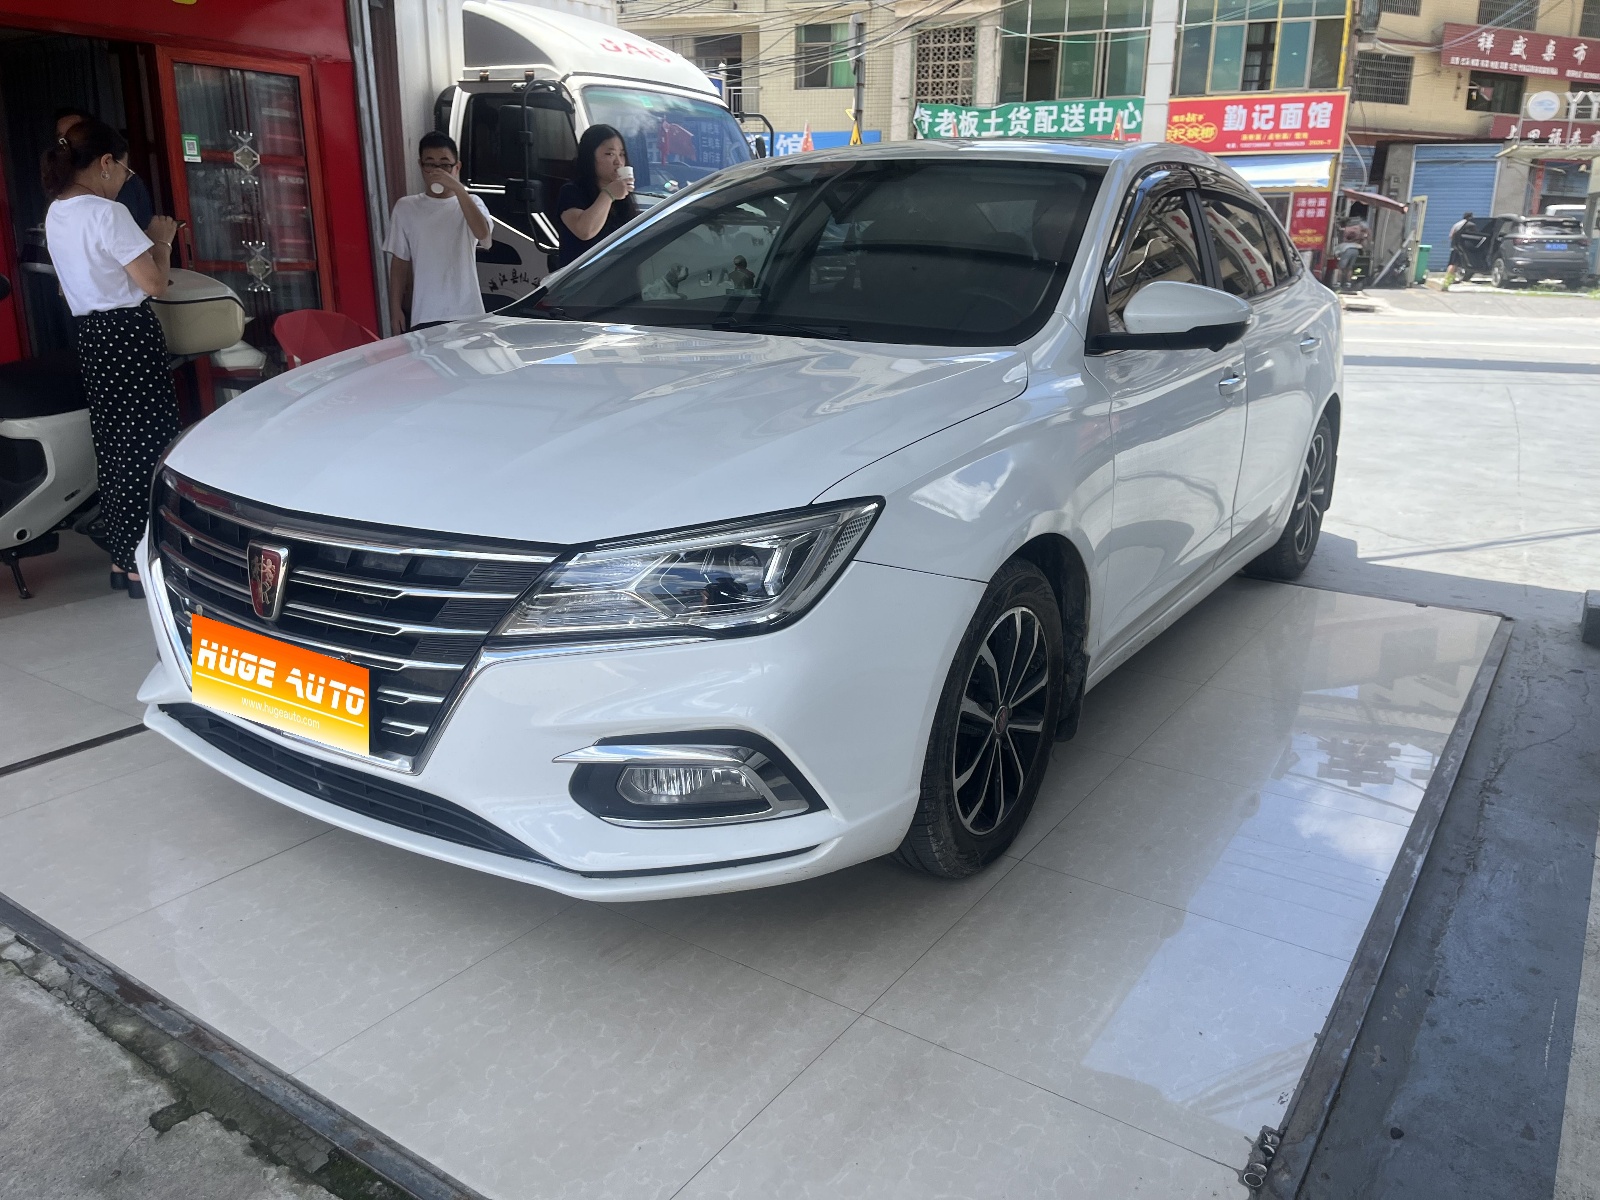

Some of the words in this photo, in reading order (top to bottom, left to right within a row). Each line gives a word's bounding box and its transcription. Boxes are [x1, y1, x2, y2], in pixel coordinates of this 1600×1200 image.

[600, 37, 671, 63] JAC
[1222, 102, 1333, 131] 勤记面馆
